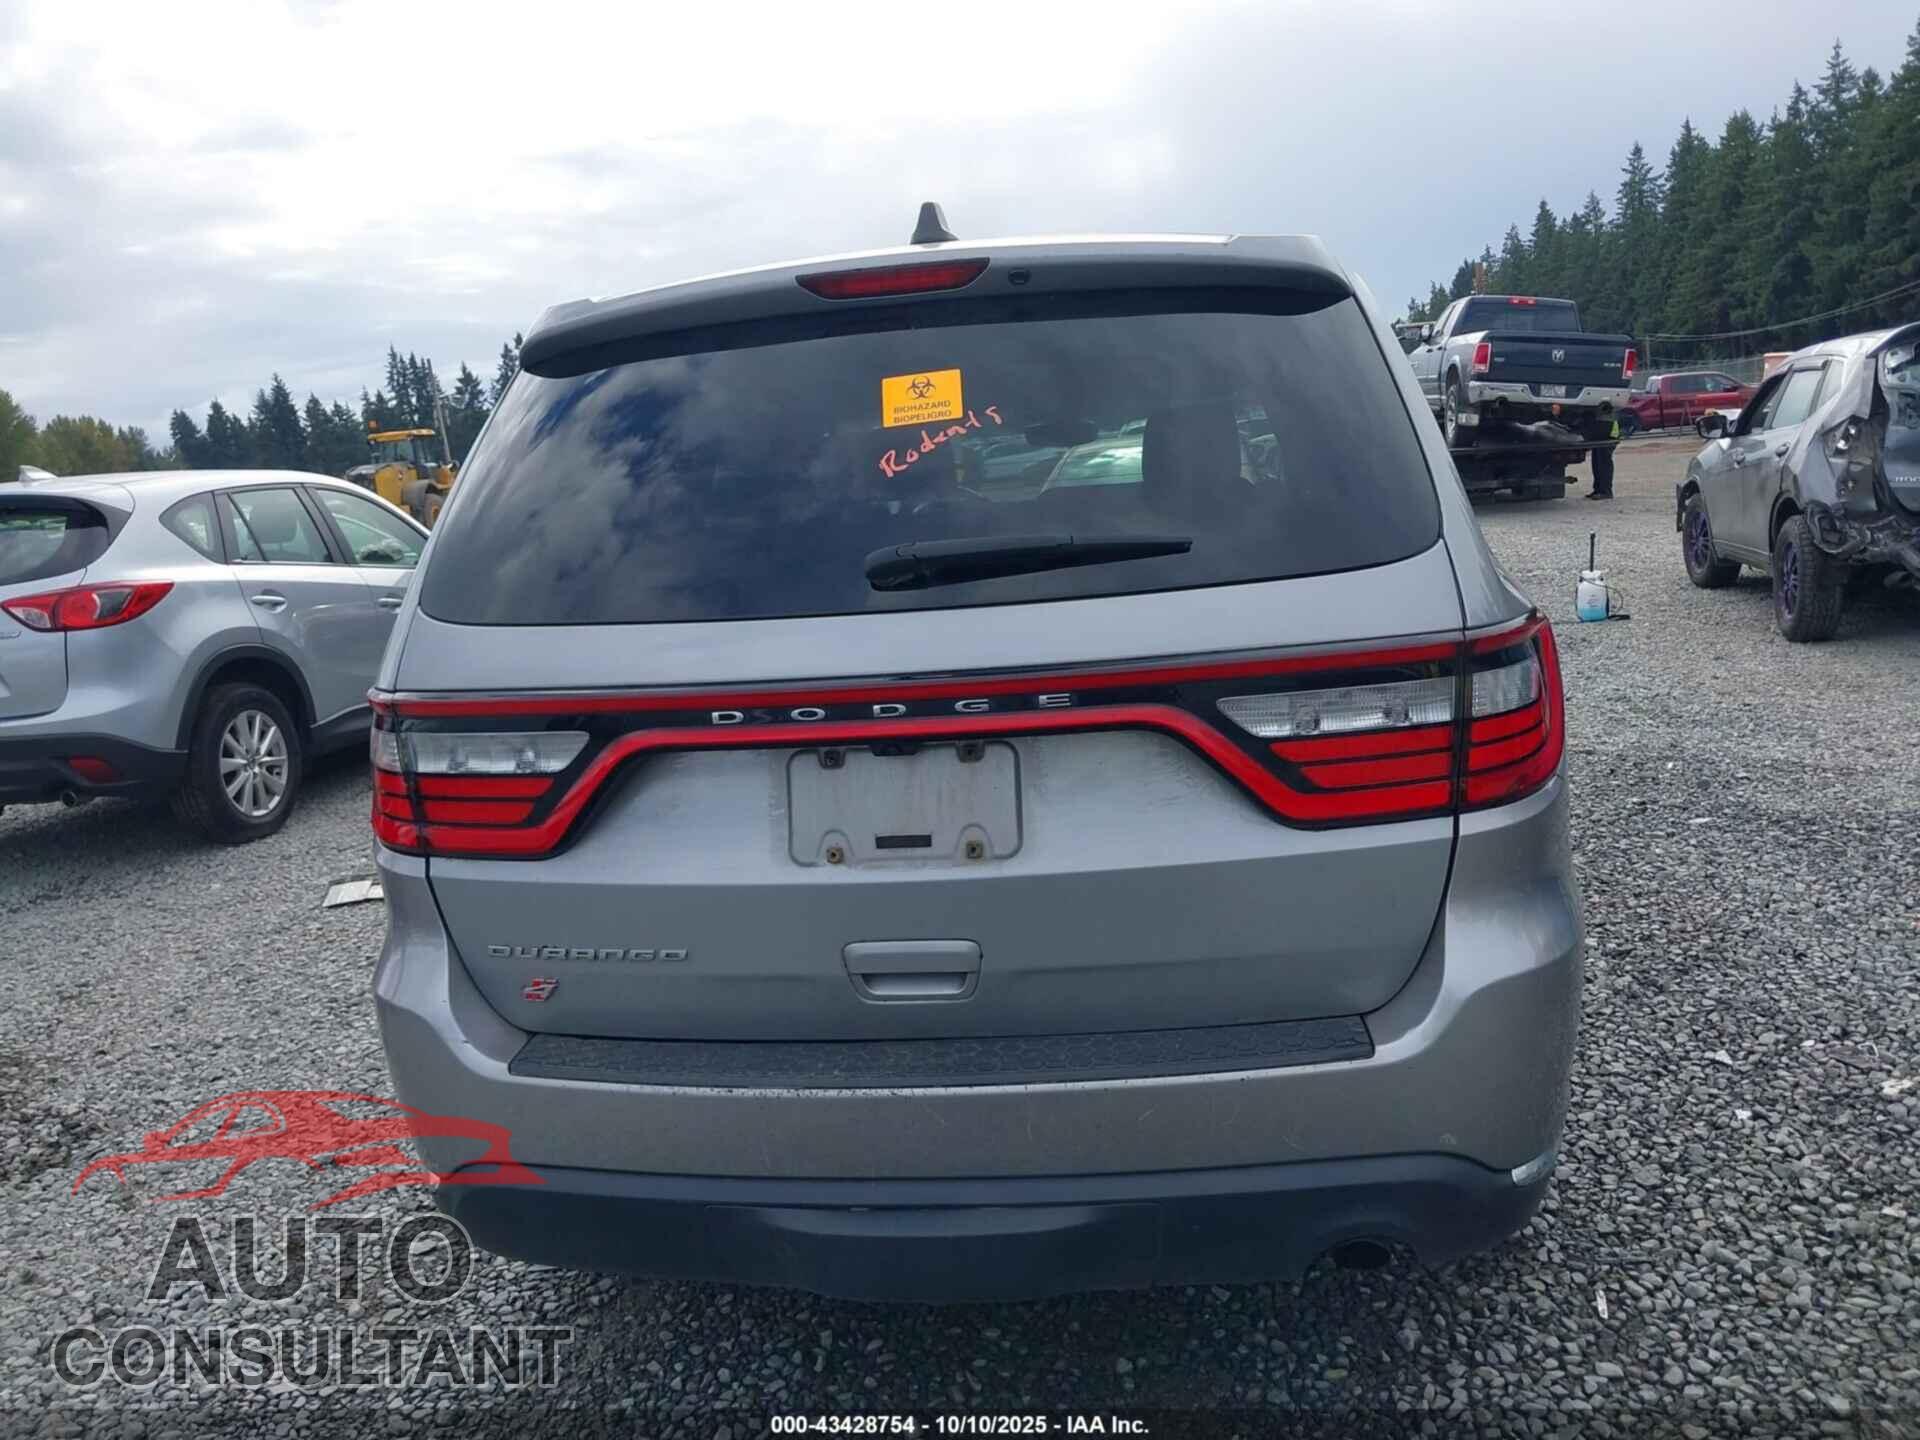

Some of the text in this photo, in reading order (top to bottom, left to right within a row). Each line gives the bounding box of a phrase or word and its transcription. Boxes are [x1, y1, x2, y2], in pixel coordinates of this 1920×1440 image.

[893, 400, 951, 415] BIOHAZARD
[893, 410, 952, 424] BIOPELIGRO
[711, 693, 1072, 725] DODGE
[487, 945, 689, 962] DURANGO
